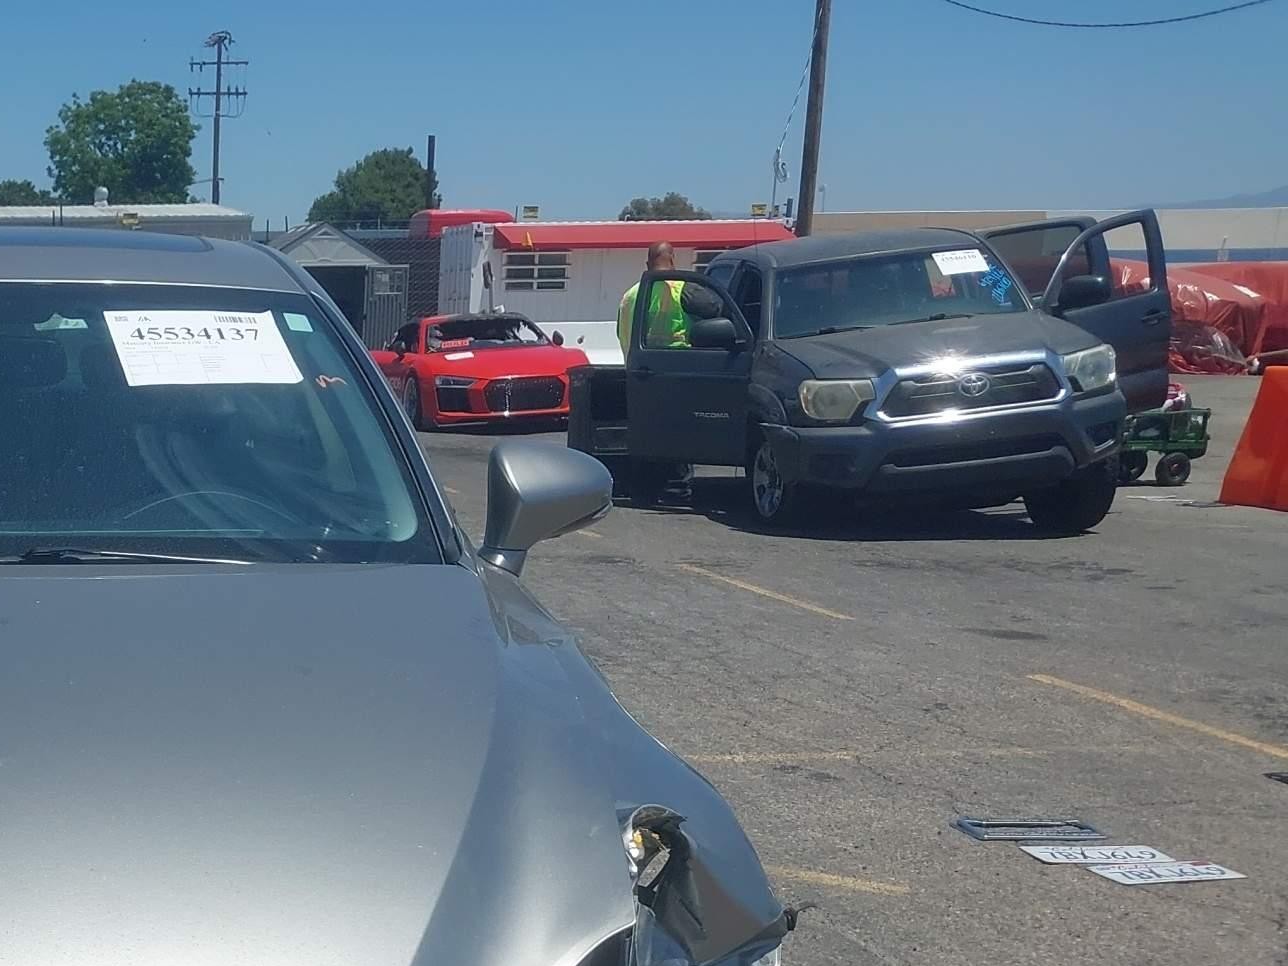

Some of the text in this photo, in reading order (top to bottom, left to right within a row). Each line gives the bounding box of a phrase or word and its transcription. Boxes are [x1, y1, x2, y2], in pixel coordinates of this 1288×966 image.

[130, 327, 259, 342] 45534137
[1039, 850, 1157, 860] 7BXJ649
[1108, 867, 1227, 880] 7BXJ649
